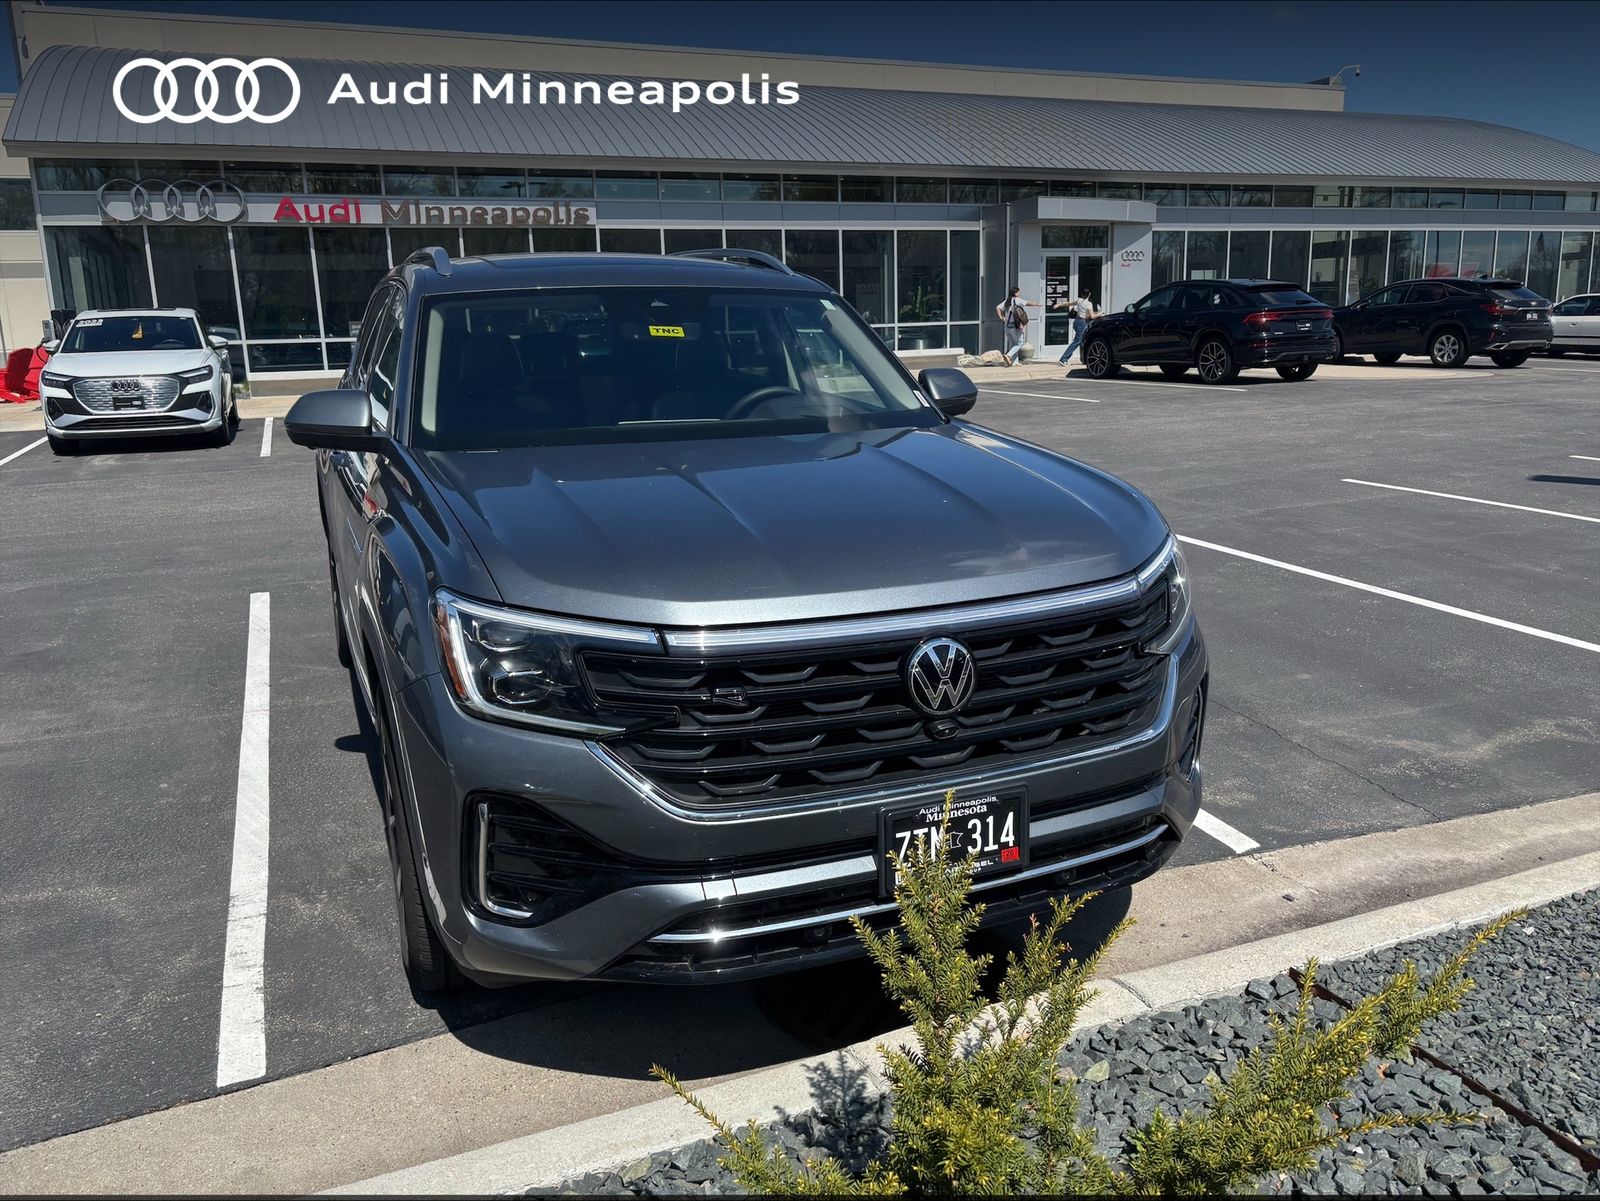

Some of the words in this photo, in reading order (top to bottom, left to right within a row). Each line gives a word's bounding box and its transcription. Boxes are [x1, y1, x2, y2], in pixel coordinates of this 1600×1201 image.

[274, 196, 361, 223] Audi
[381, 200, 591, 226] Minneapolis
[919, 805, 940, 816] Audi
[967, 811, 1014, 853] 314
